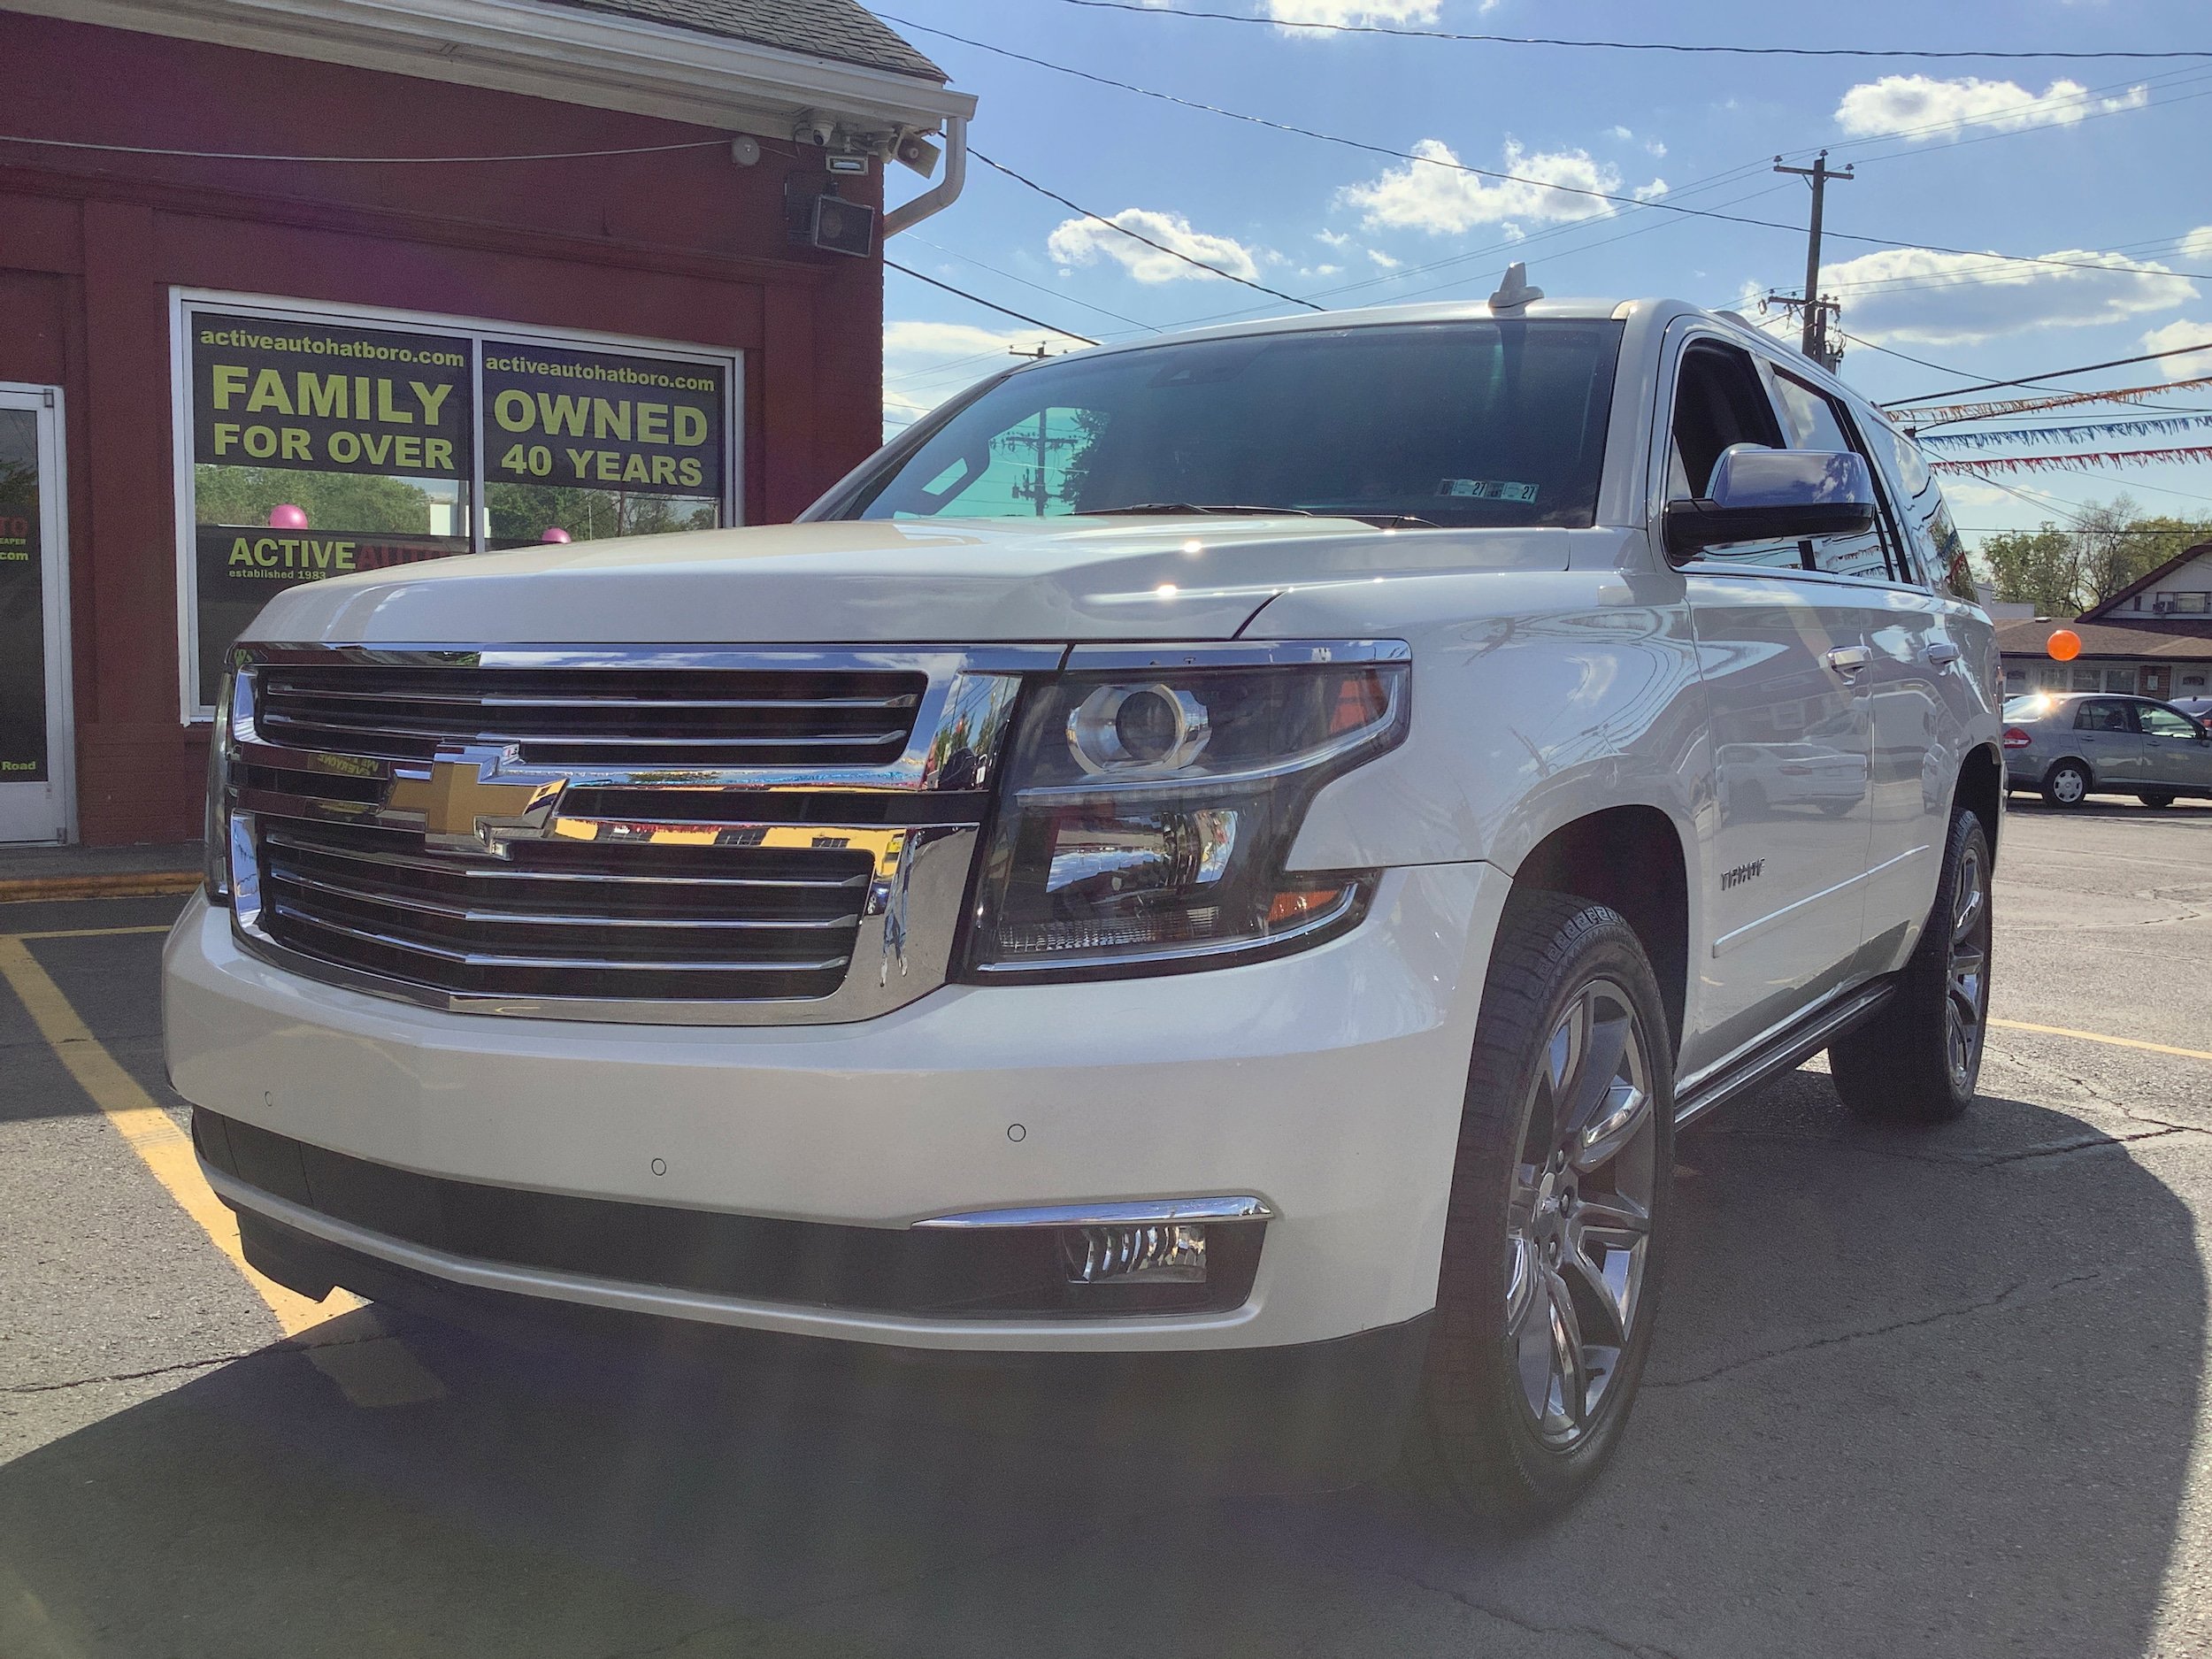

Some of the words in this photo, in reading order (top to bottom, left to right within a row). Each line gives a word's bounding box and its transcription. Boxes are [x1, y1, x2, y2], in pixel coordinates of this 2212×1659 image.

[201, 329, 465, 368] activeautohatboro.com
[487, 357, 715, 392] activeautohatboro.com
[212, 364, 454, 426] FAMILY
[494, 389, 708, 447] OWNED
[214, 423, 313, 461] FOR
[327, 431, 455, 470] OVER
[501, 443, 552, 476] 40
[566, 448, 703, 487] YEARS
[228, 537, 357, 571] ACTIVE
[228, 568, 295, 580] established
[297, 570, 326, 580] 1983
[2, 761, 36, 771] Road
